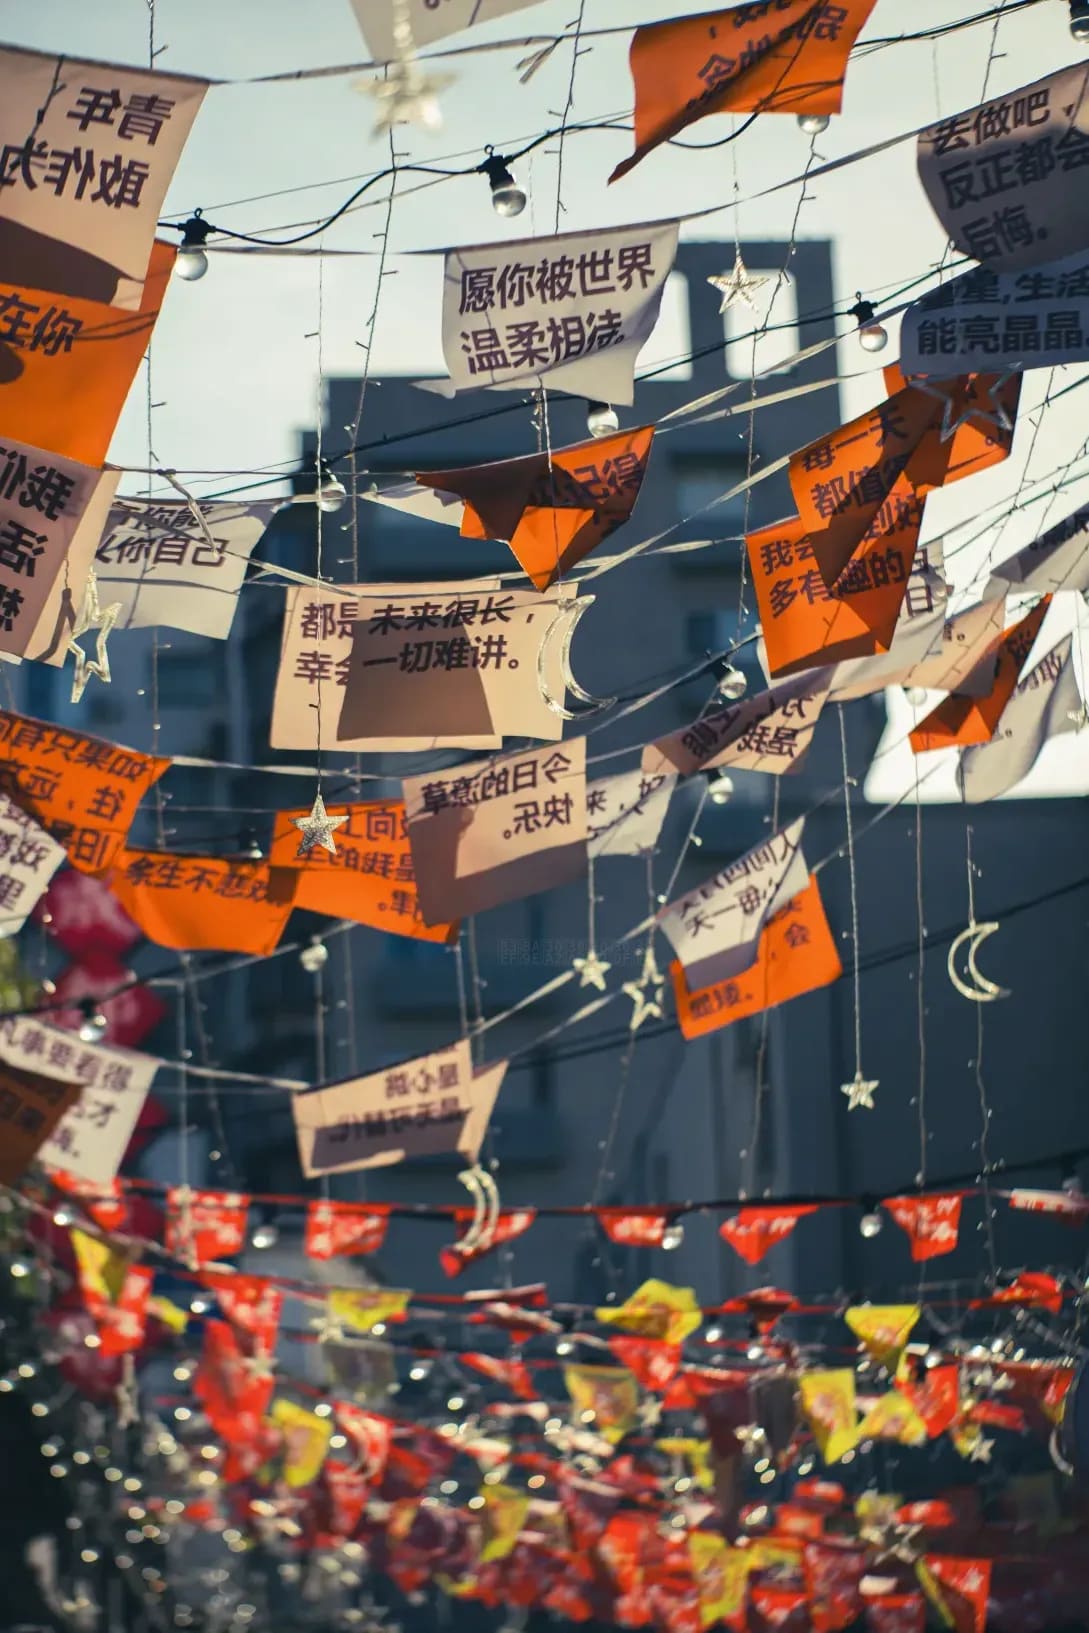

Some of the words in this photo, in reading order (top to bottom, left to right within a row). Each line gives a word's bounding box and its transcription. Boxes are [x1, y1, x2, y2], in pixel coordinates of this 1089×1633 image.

[938, 125, 1089, 209] 反正都会
[458, 243, 655, 315] 愿你被世界
[0, 293, 84, 357] 在你
[460, 309, 626, 374] 温柔相待。
[801, 404, 908, 473] 每一天
[368, 595, 535, 636] 未来很长，
[362, 634, 521, 673] 一切难讲。
